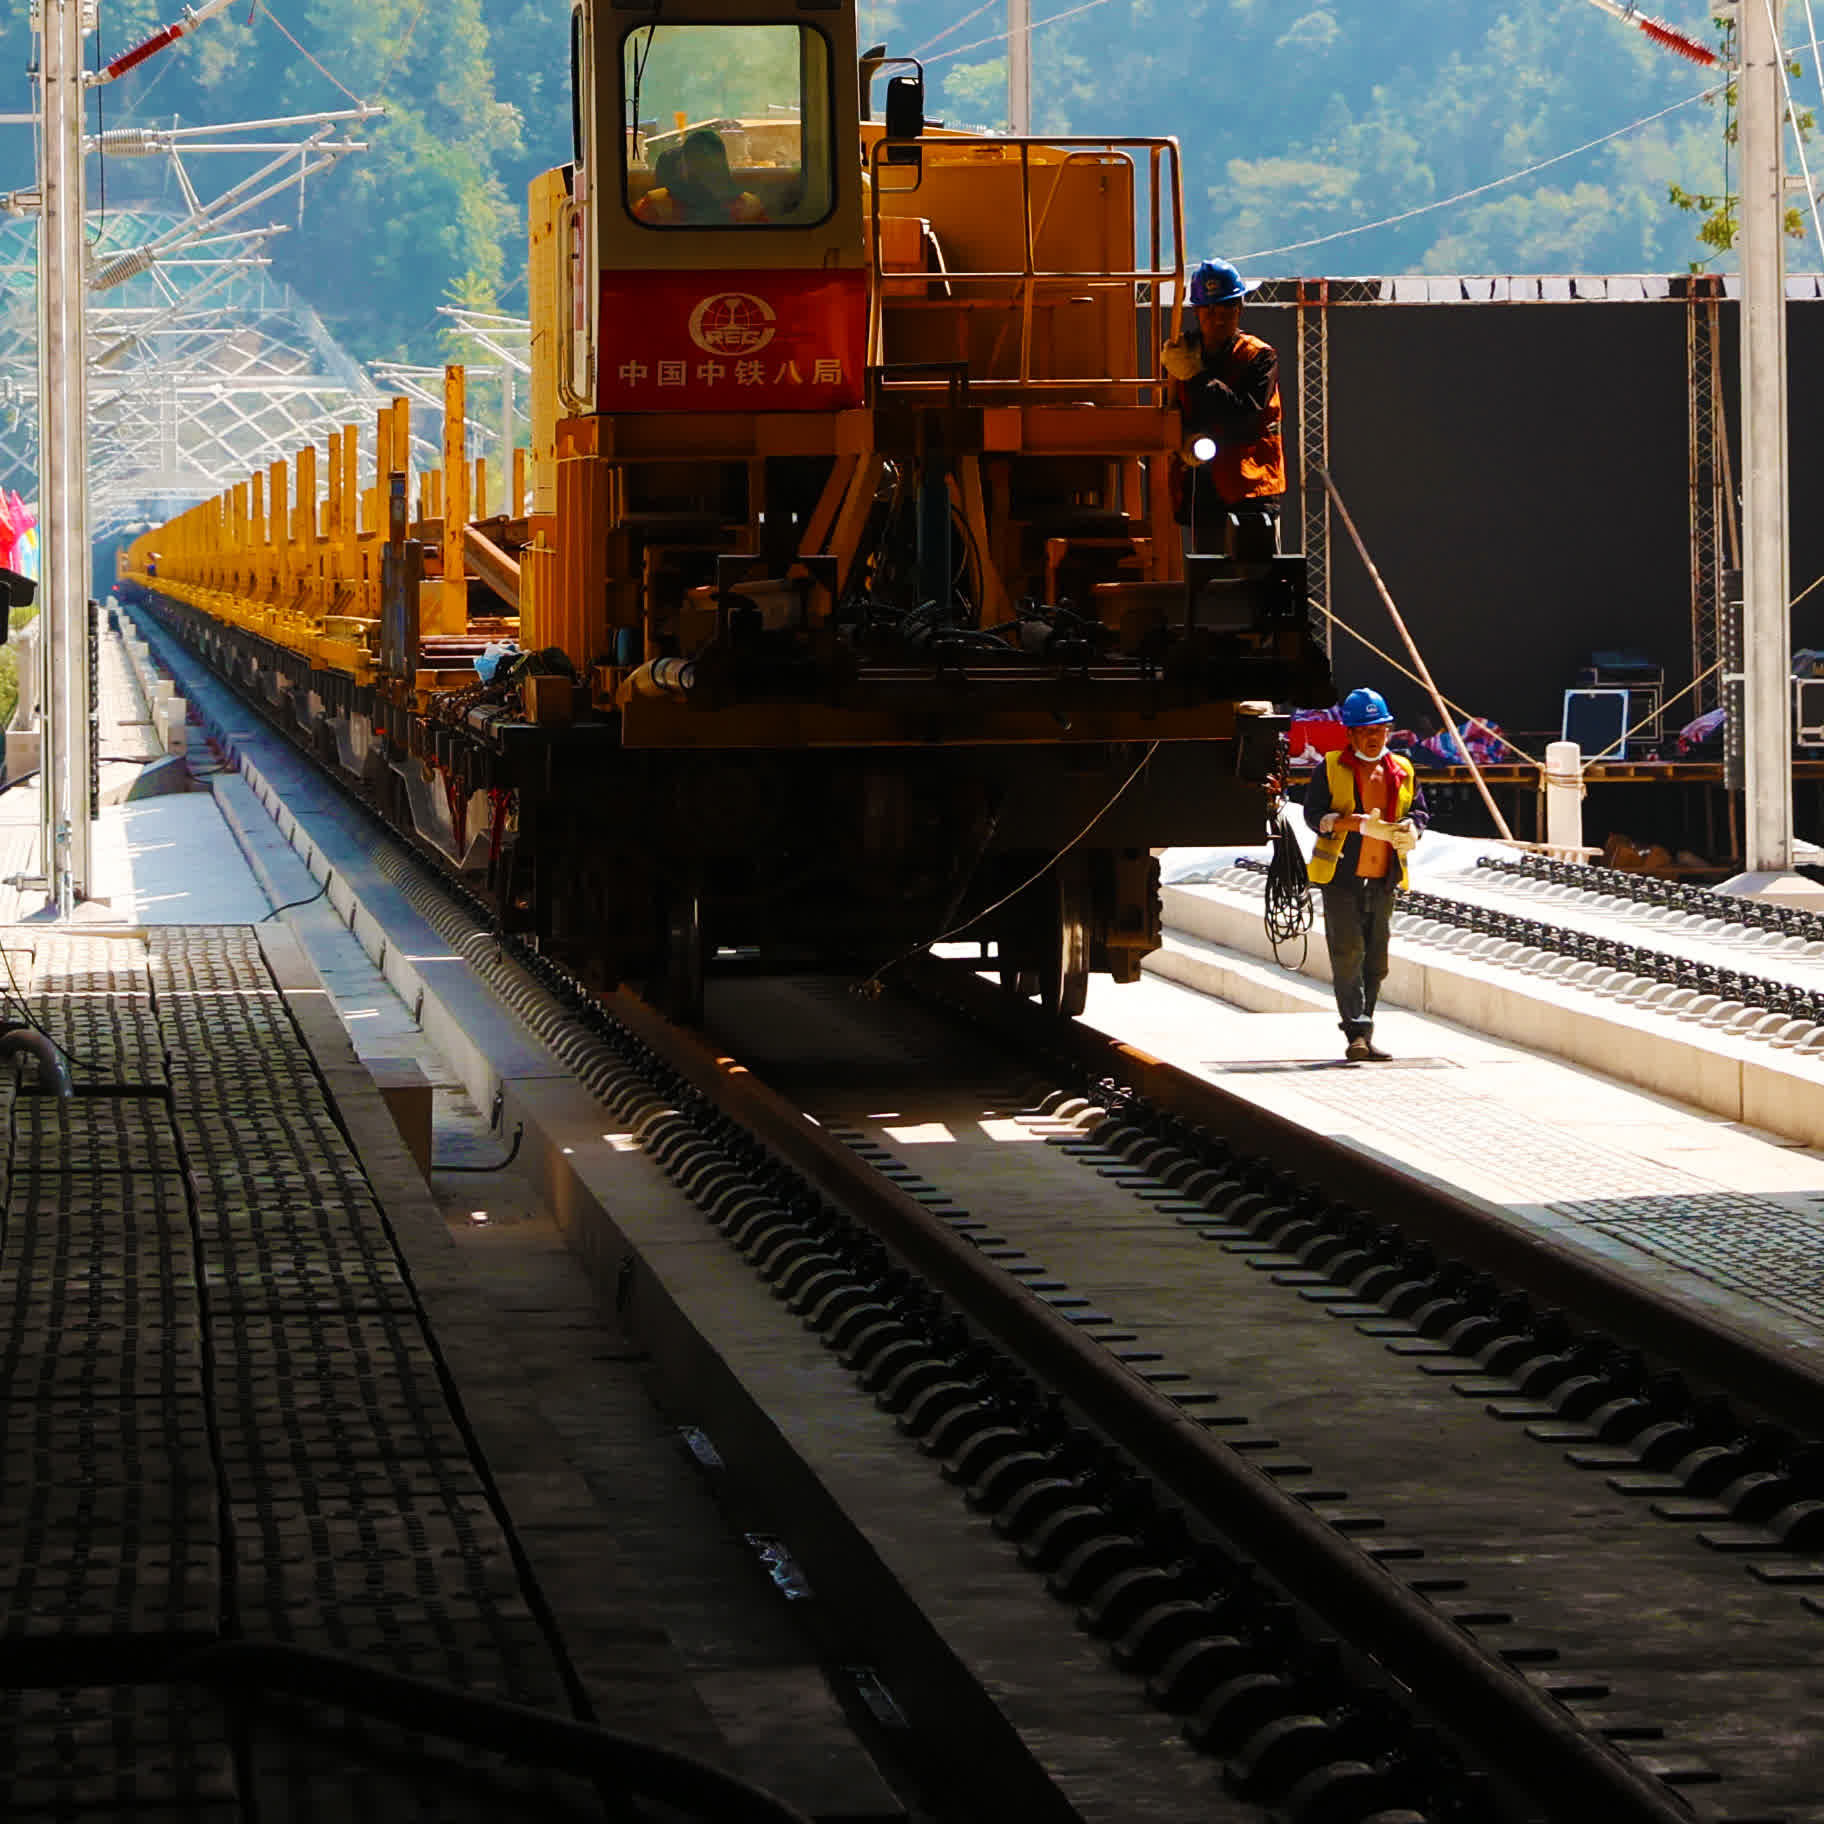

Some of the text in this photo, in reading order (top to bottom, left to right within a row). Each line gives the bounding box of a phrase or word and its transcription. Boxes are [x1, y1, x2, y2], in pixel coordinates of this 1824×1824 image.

[618, 359, 842, 388] 中国中铁八局
